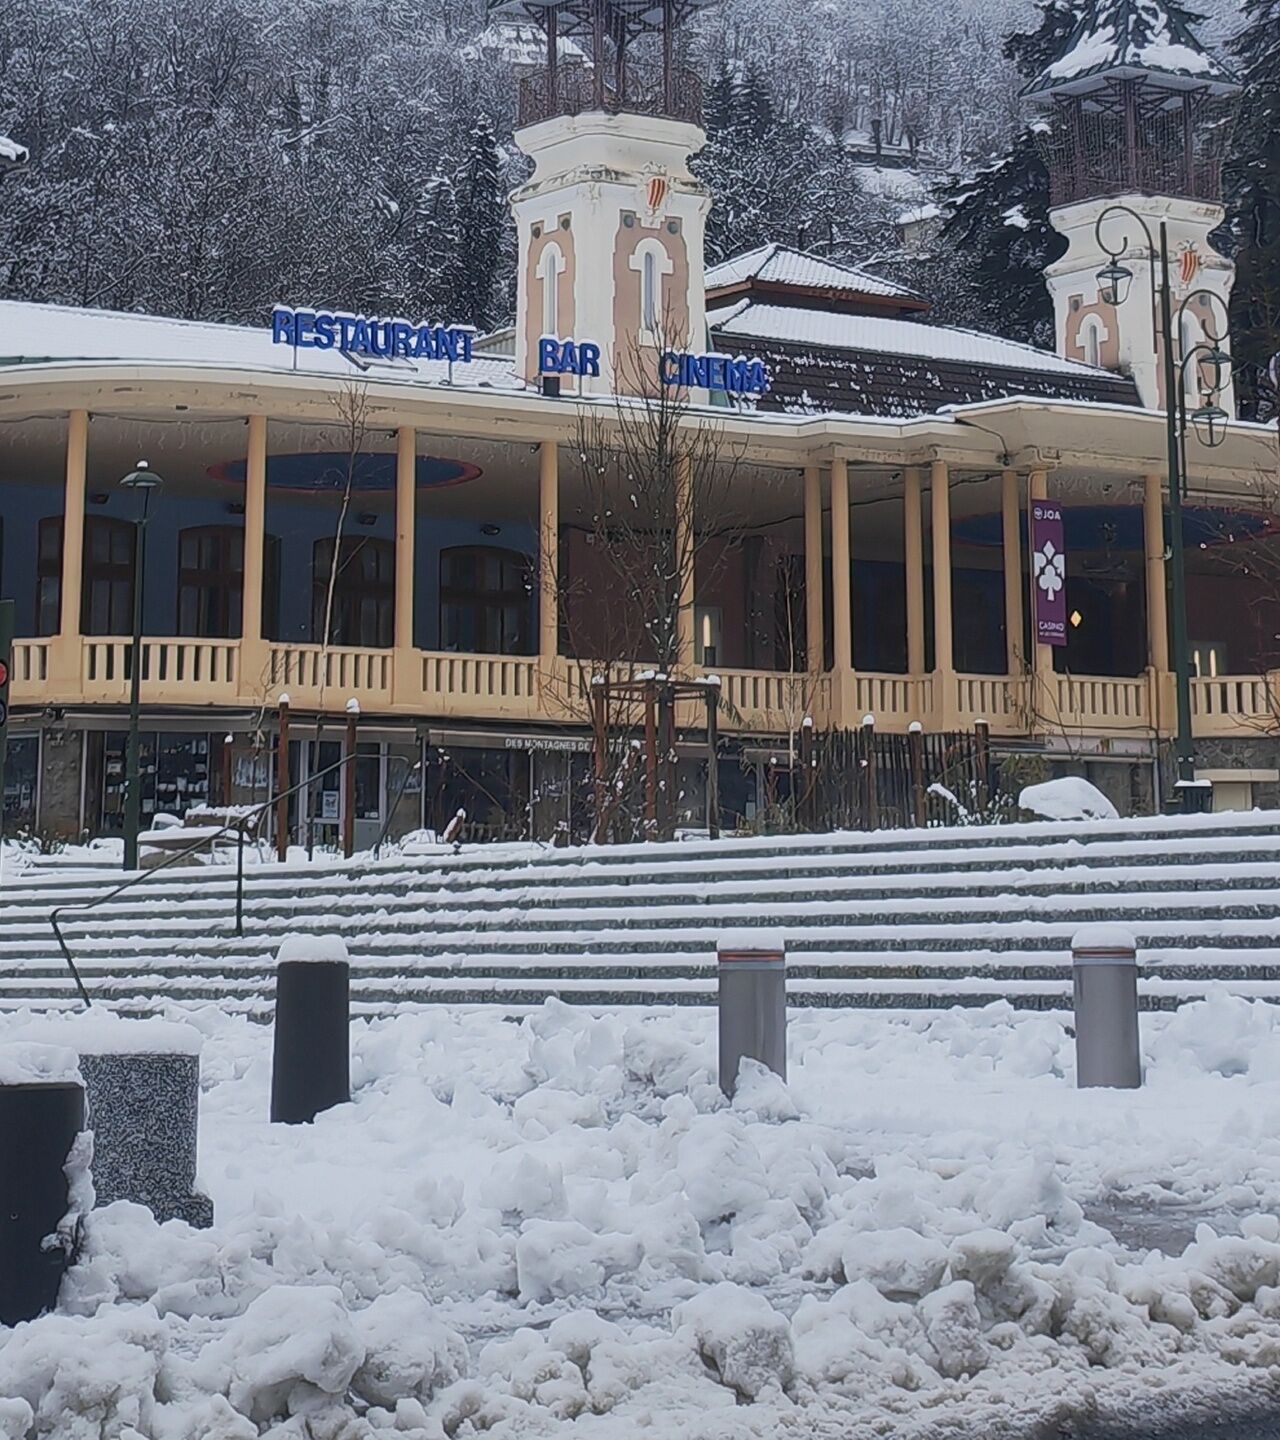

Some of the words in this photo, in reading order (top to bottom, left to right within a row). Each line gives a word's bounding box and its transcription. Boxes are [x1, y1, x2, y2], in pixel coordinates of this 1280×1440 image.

[272, 307, 474, 362] RESTAURANT
[539, 338, 600, 377] BAR
[661, 351, 767, 394] CINEMA
[1043, 509, 1061, 520] JOA
[505, 738, 522, 749] DES
[524, 739, 576, 751] MONTAGNES
